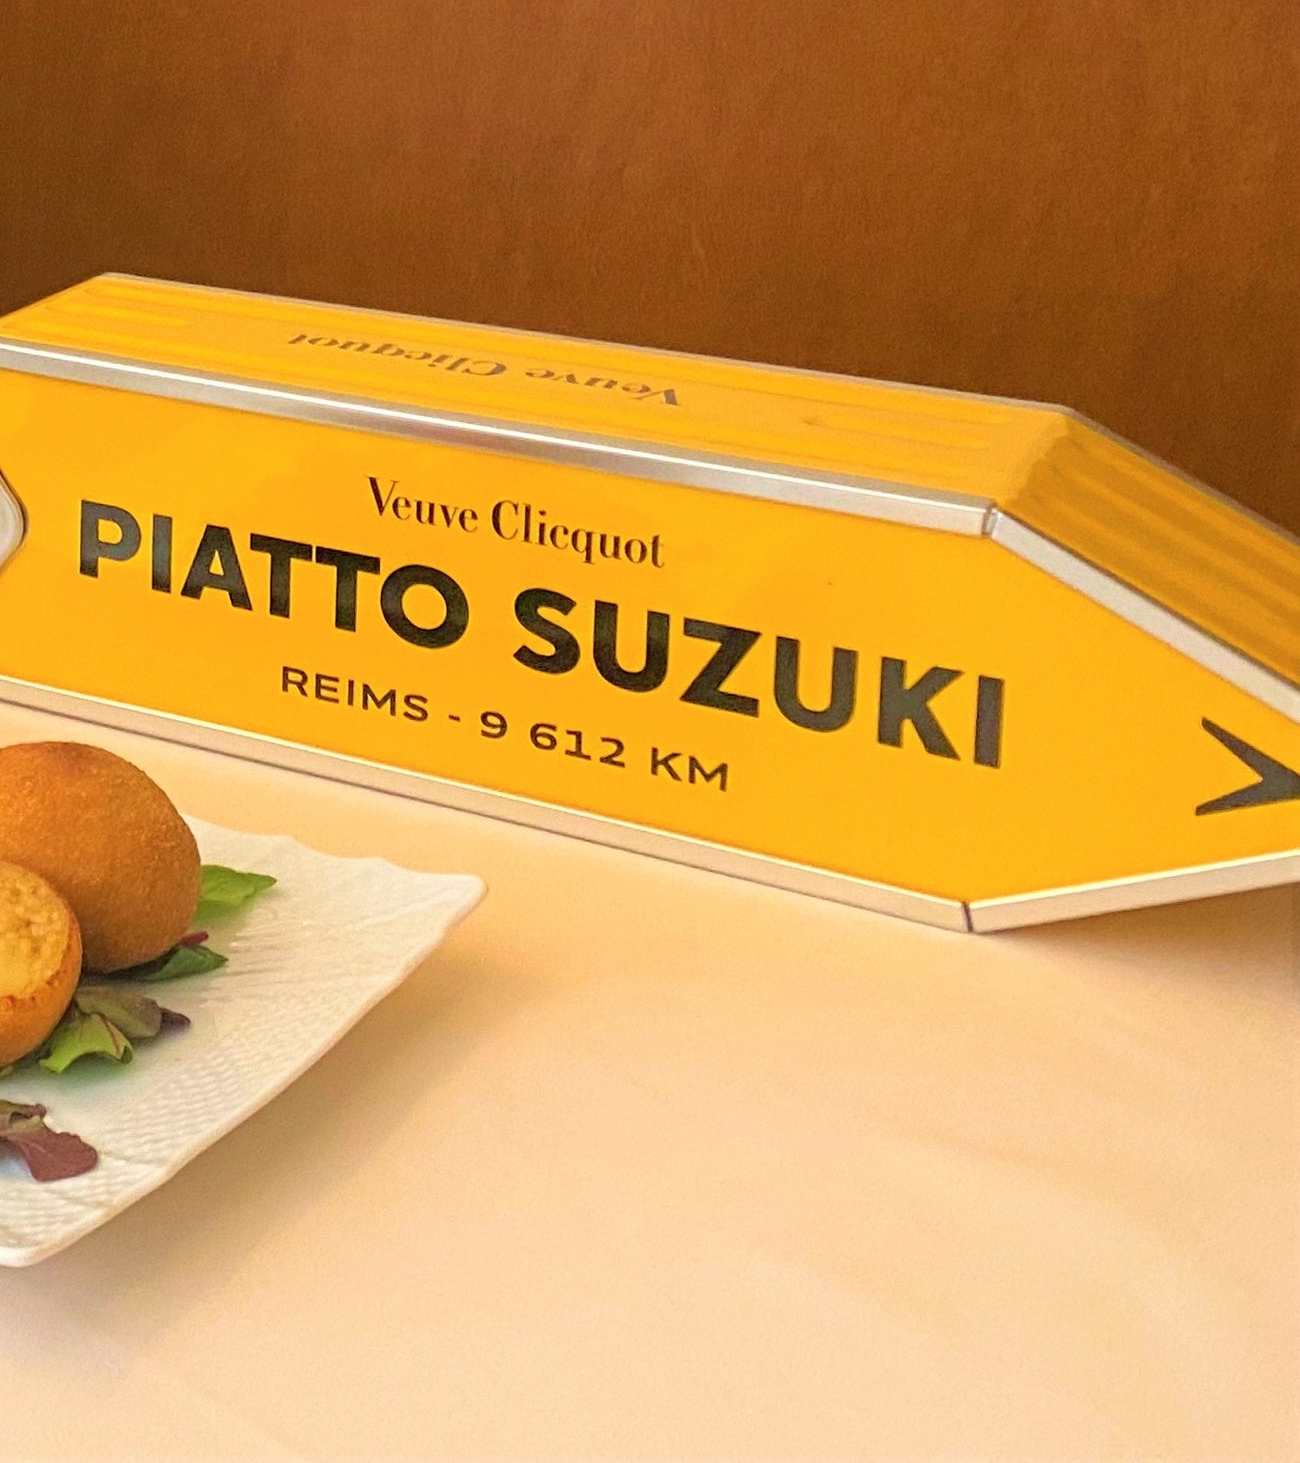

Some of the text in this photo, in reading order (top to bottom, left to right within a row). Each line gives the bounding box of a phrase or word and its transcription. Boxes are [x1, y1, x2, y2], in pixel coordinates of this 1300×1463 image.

[287, 332, 680, 406] Veuve Clicquot
[364, 475, 666, 568] Veuve Clicquot
[79, 499, 1004, 768] PIATTO SUZUKI
[281, 665, 730, 793] REIMS - 9 612 KM
